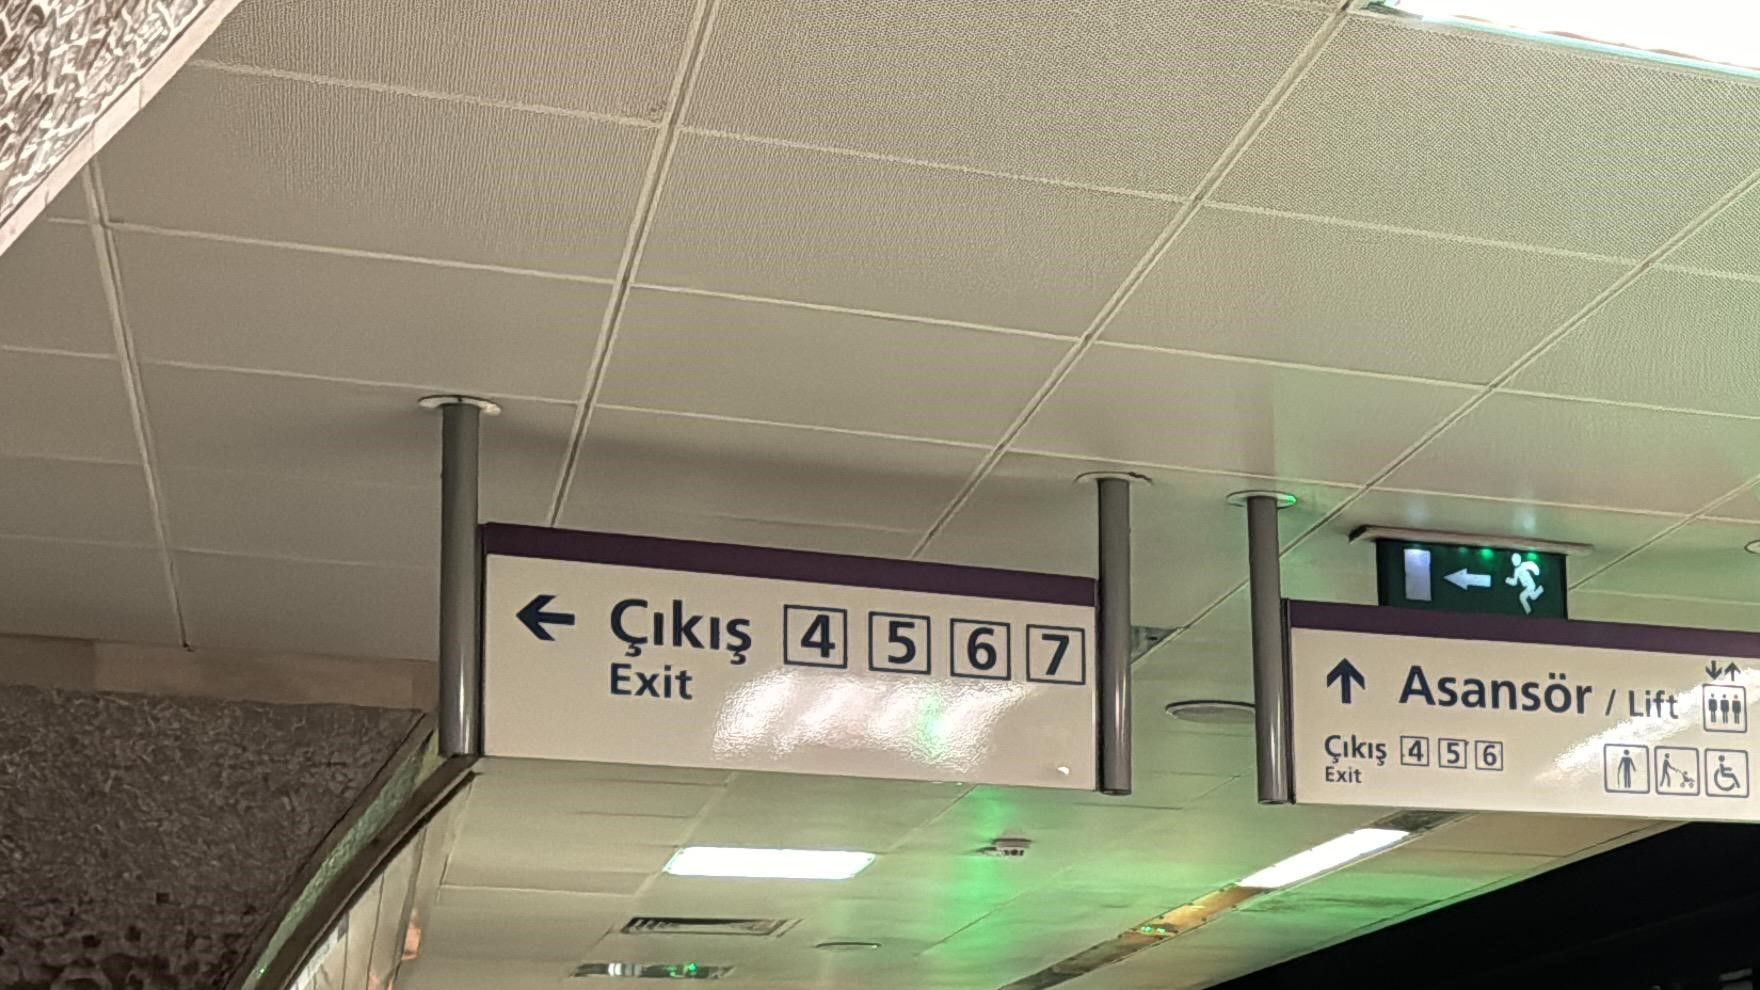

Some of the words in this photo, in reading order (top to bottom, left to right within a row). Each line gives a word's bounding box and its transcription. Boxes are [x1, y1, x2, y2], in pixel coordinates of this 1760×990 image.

[610, 598, 752, 666] Çıkış
[800, 613, 836, 659] 4
[887, 620, 917, 665] 5
[966, 626, 997, 671] 6
[1041, 632, 1070, 676] 7
[610, 662, 693, 701] Exit
[1398, 665, 1593, 714] Asansör
[1604, 688, 1617, 717] /
[1627, 689, 1679, 720] Lift
[1324, 734, 1388, 767] Çıkış
[1408, 739, 1425, 763] 4
[1446, 742, 1461, 765] 5
[1482, 744, 1498, 767] 6
[1325, 765, 1363, 784] Exit
